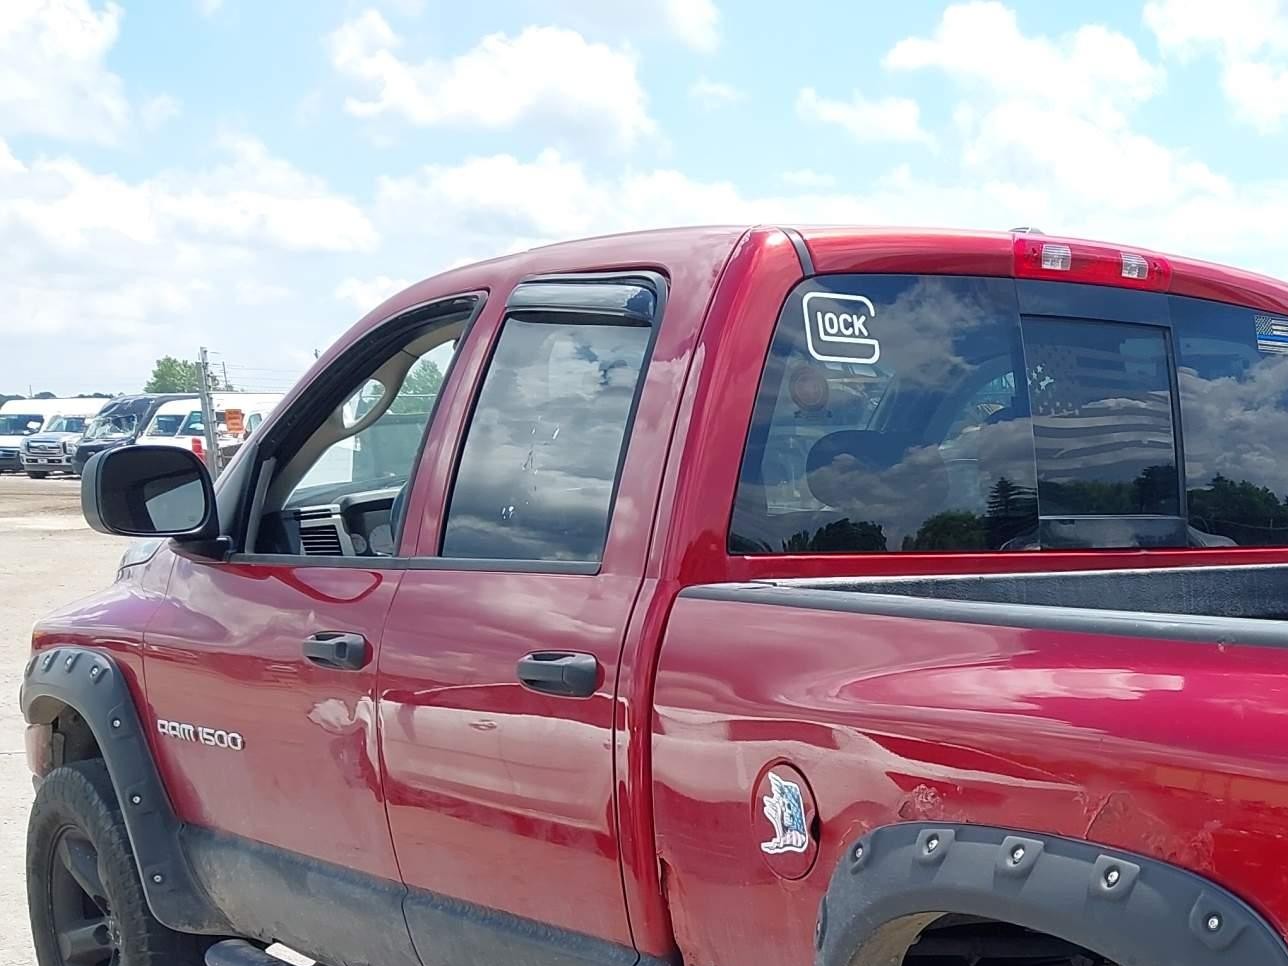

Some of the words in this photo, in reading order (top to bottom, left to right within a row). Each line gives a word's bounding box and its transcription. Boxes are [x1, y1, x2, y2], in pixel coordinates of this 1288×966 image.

[803, 291, 880, 364] GLOCK
[157, 719, 197, 742] RAM
[197, 726, 246, 751] 1500
